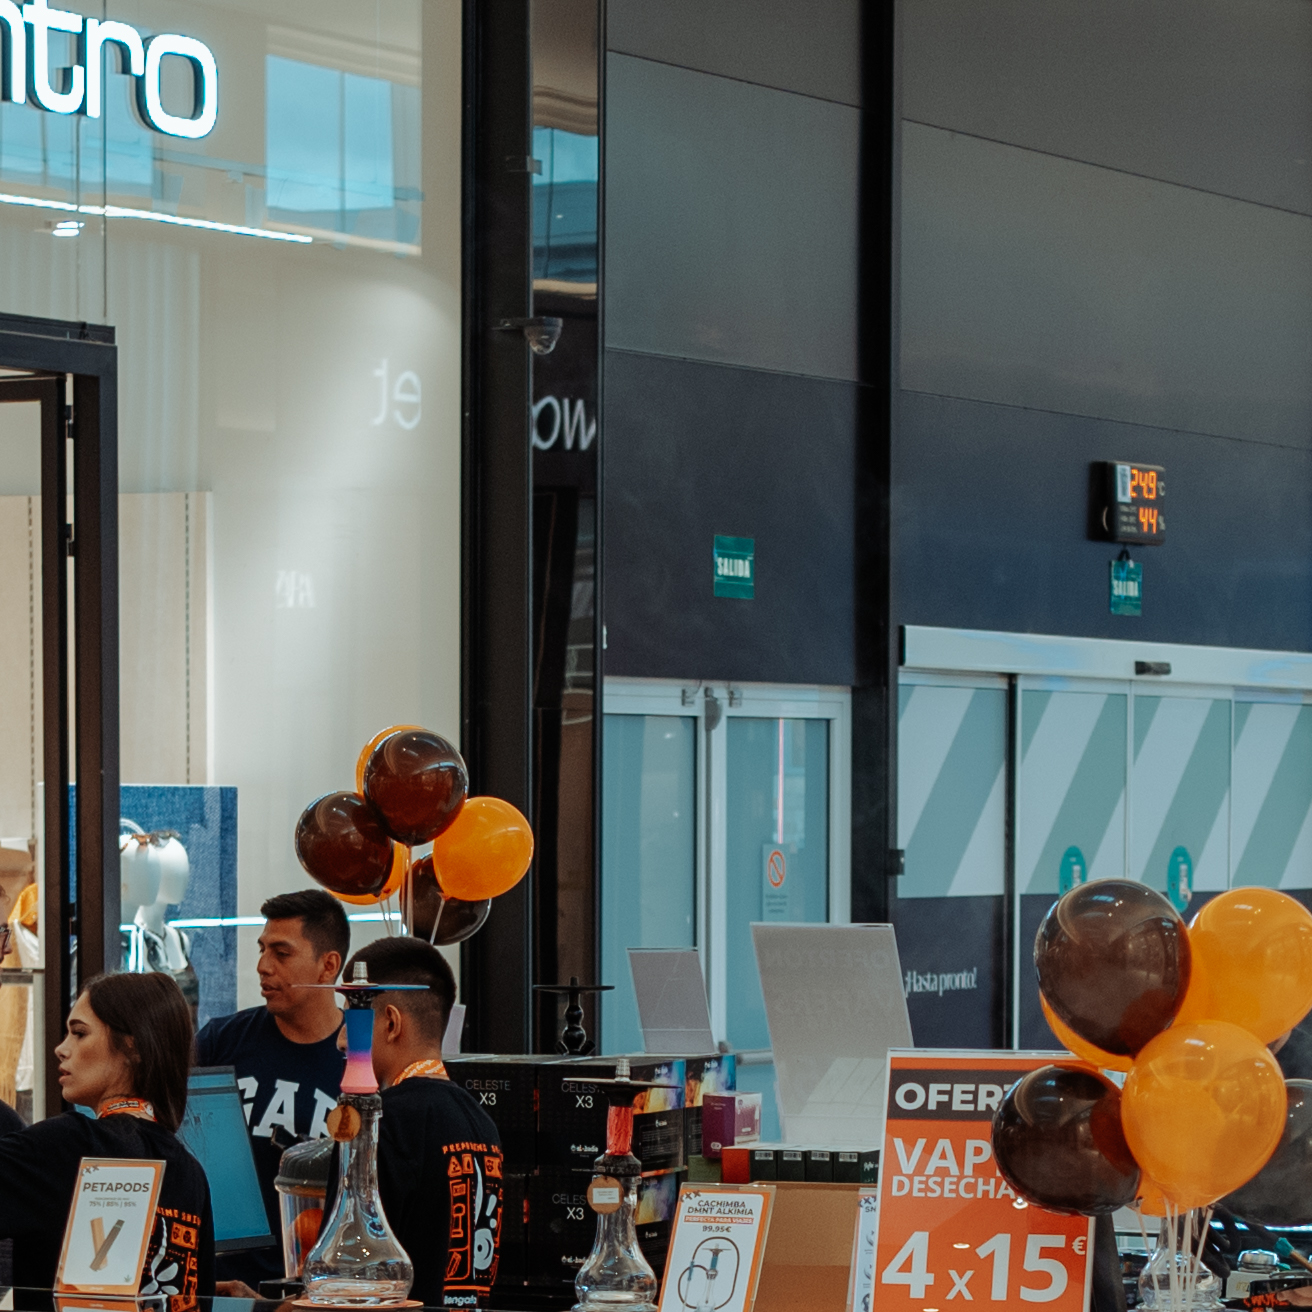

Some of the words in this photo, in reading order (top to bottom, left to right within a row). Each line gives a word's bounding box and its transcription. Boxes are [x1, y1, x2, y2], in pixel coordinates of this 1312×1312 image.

[1139, 506, 1158, 534] 44
[716, 556, 751, 580] SALIDA
[938, 966, 978, 997] pronto!
[465, 1080, 511, 1091] CELESTE
[561, 1081, 605, 1094] CELES
[479, 1092, 497, 1106] X3
[575, 1095, 594, 1109] X3
[895, 1082, 1008, 1112] OFER
[892, 1137, 1001, 1177] VAP
[82, 1182, 150, 1193] PETAPODS
[697, 1200, 746, 1208] CACHIMBA
[566, 1207, 585, 1221] X3
[715, 1207, 754, 1216] ALKIMIA
[881, 1230, 935, 1299] 4
